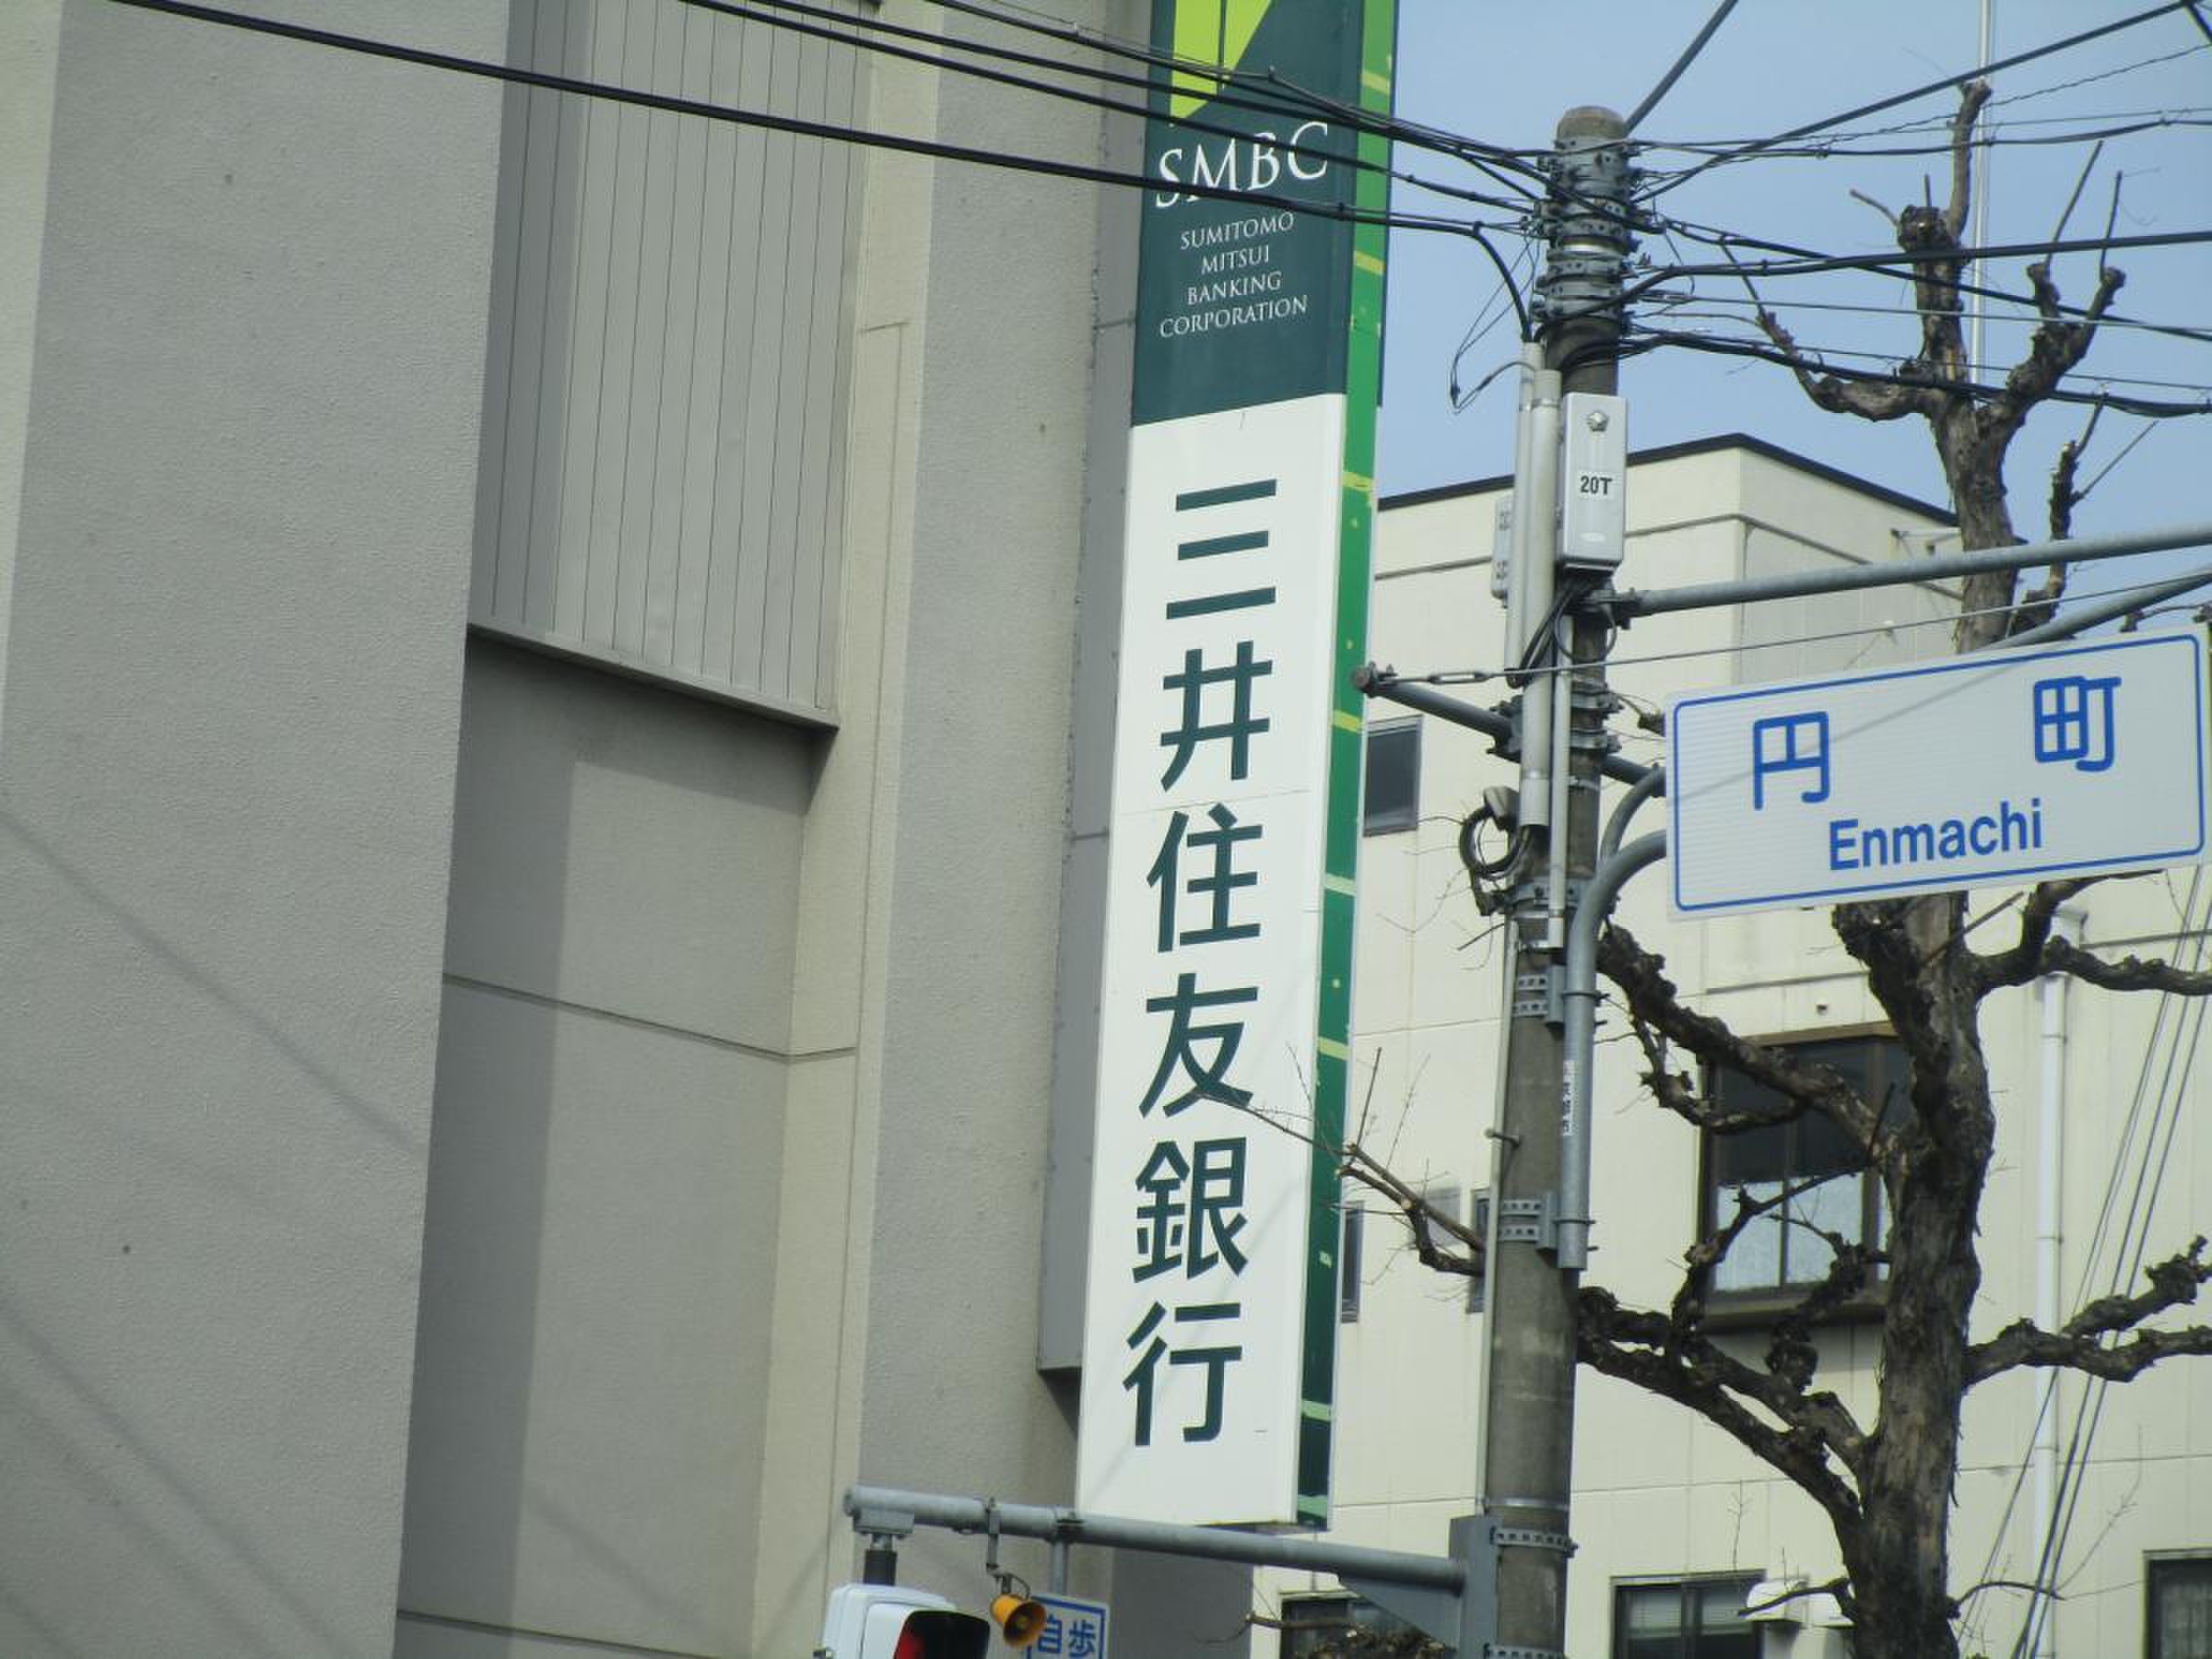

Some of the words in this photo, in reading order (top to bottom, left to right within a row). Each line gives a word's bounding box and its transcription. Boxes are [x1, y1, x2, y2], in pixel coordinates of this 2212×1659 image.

[1155, 121, 1328, 208] SMBC
[1180, 211, 1295, 251] SUMITOMO
[1200, 244, 1270, 276] MITSUI
[1186, 271, 1282, 306] BANKING
[1159, 294, 1308, 339] CORPORATION
[1580, 475, 1613, 495] 20T
[1752, 675, 2122, 811] 円町
[1829, 797, 2043, 871] Enmachi
[1123, 478, 1277, 1447] 三井住友銀行
